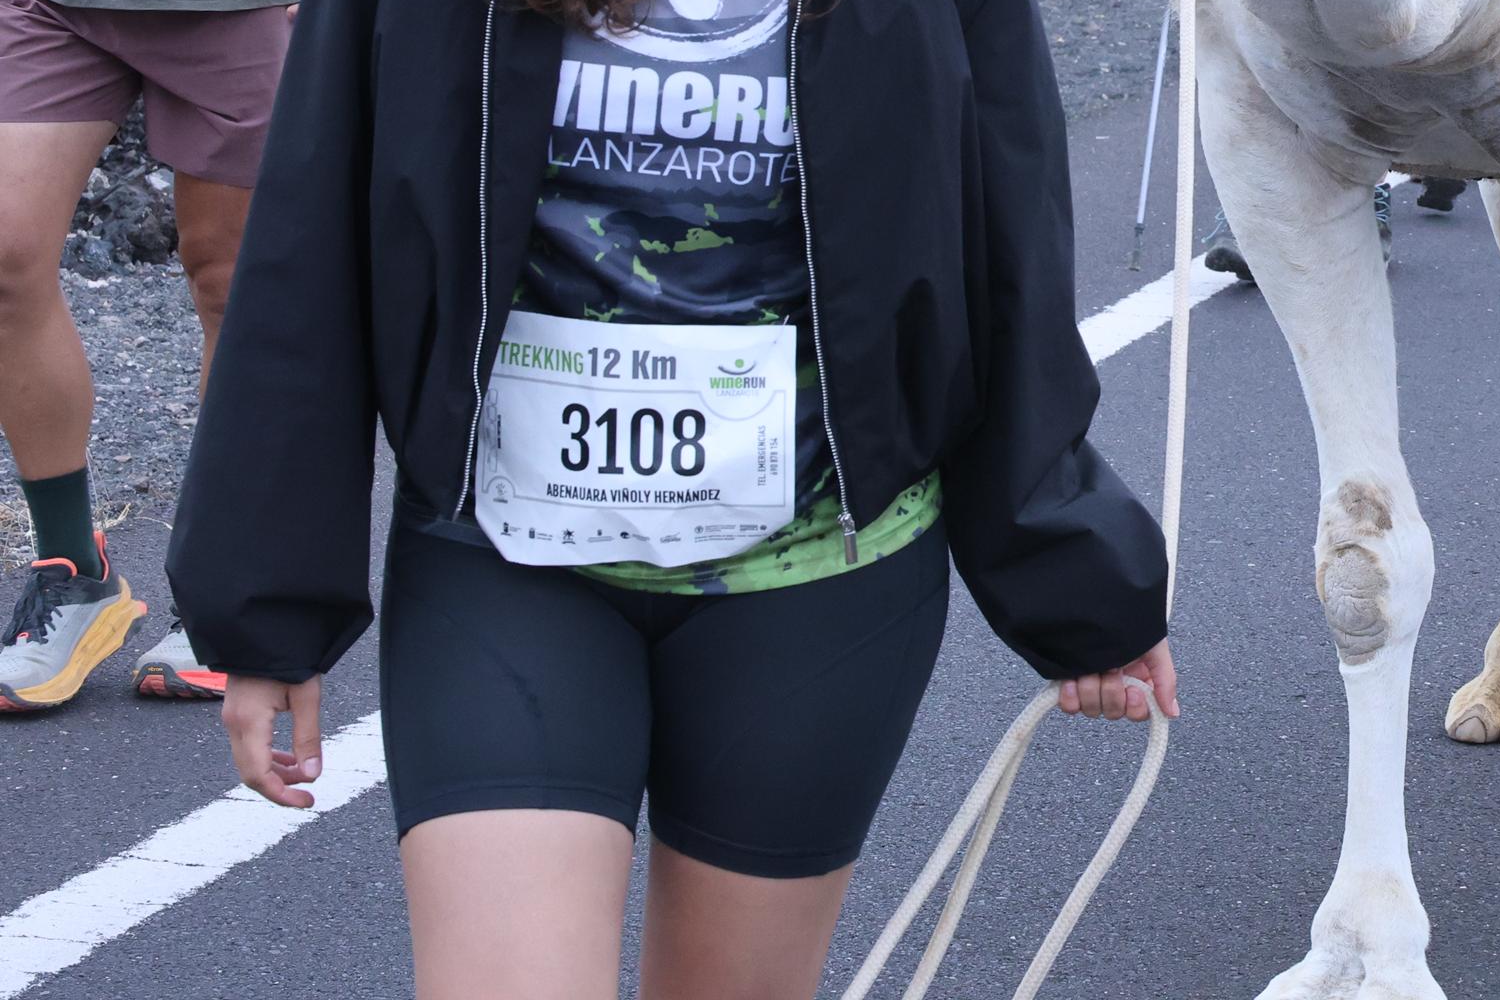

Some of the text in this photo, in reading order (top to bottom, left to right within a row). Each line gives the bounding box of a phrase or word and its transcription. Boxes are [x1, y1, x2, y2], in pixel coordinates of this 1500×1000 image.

[548, 135, 798, 187] LANZAROTE
[499, 341, 677, 380] TREKKING 12 Km
[560, 403, 707, 478] 3108
[546, 483, 720, 504] ABENAUARA VIÑOLY HERNÁNDEZ
